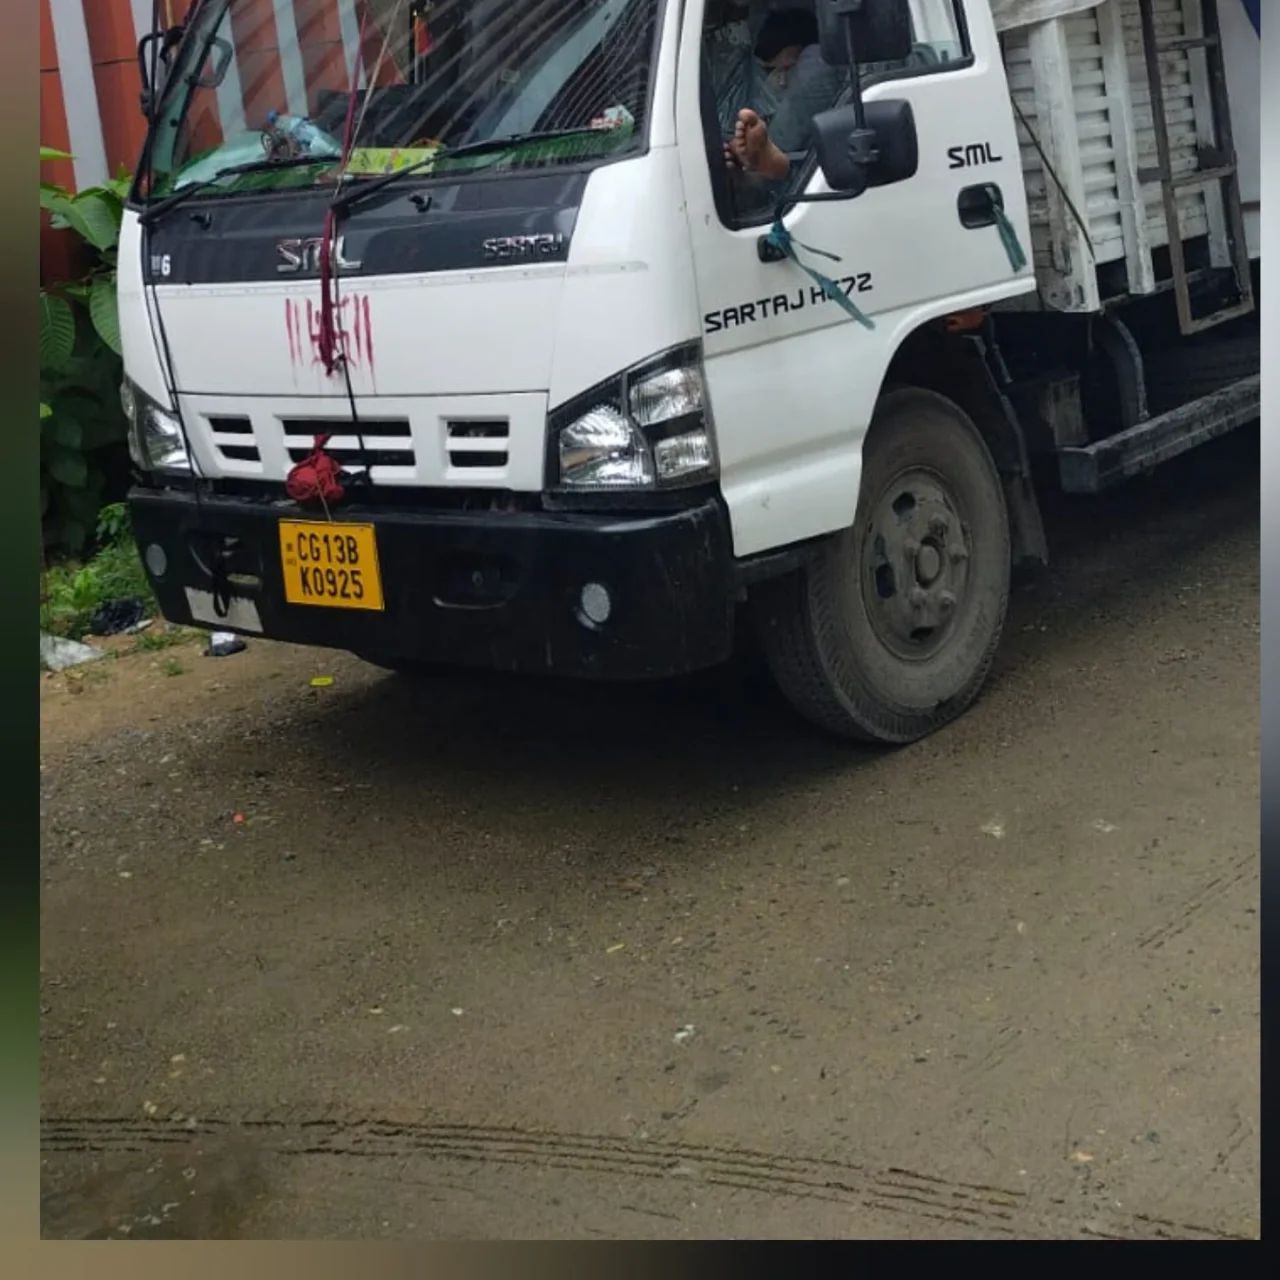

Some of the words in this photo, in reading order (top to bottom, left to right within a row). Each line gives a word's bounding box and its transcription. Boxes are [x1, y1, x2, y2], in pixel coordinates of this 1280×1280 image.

[946, 141, 1003, 170] SML
[703, 289, 804, 334] SARTAJ
[297, 531, 359, 565] CG13B
[300, 566, 364, 599] K0925
